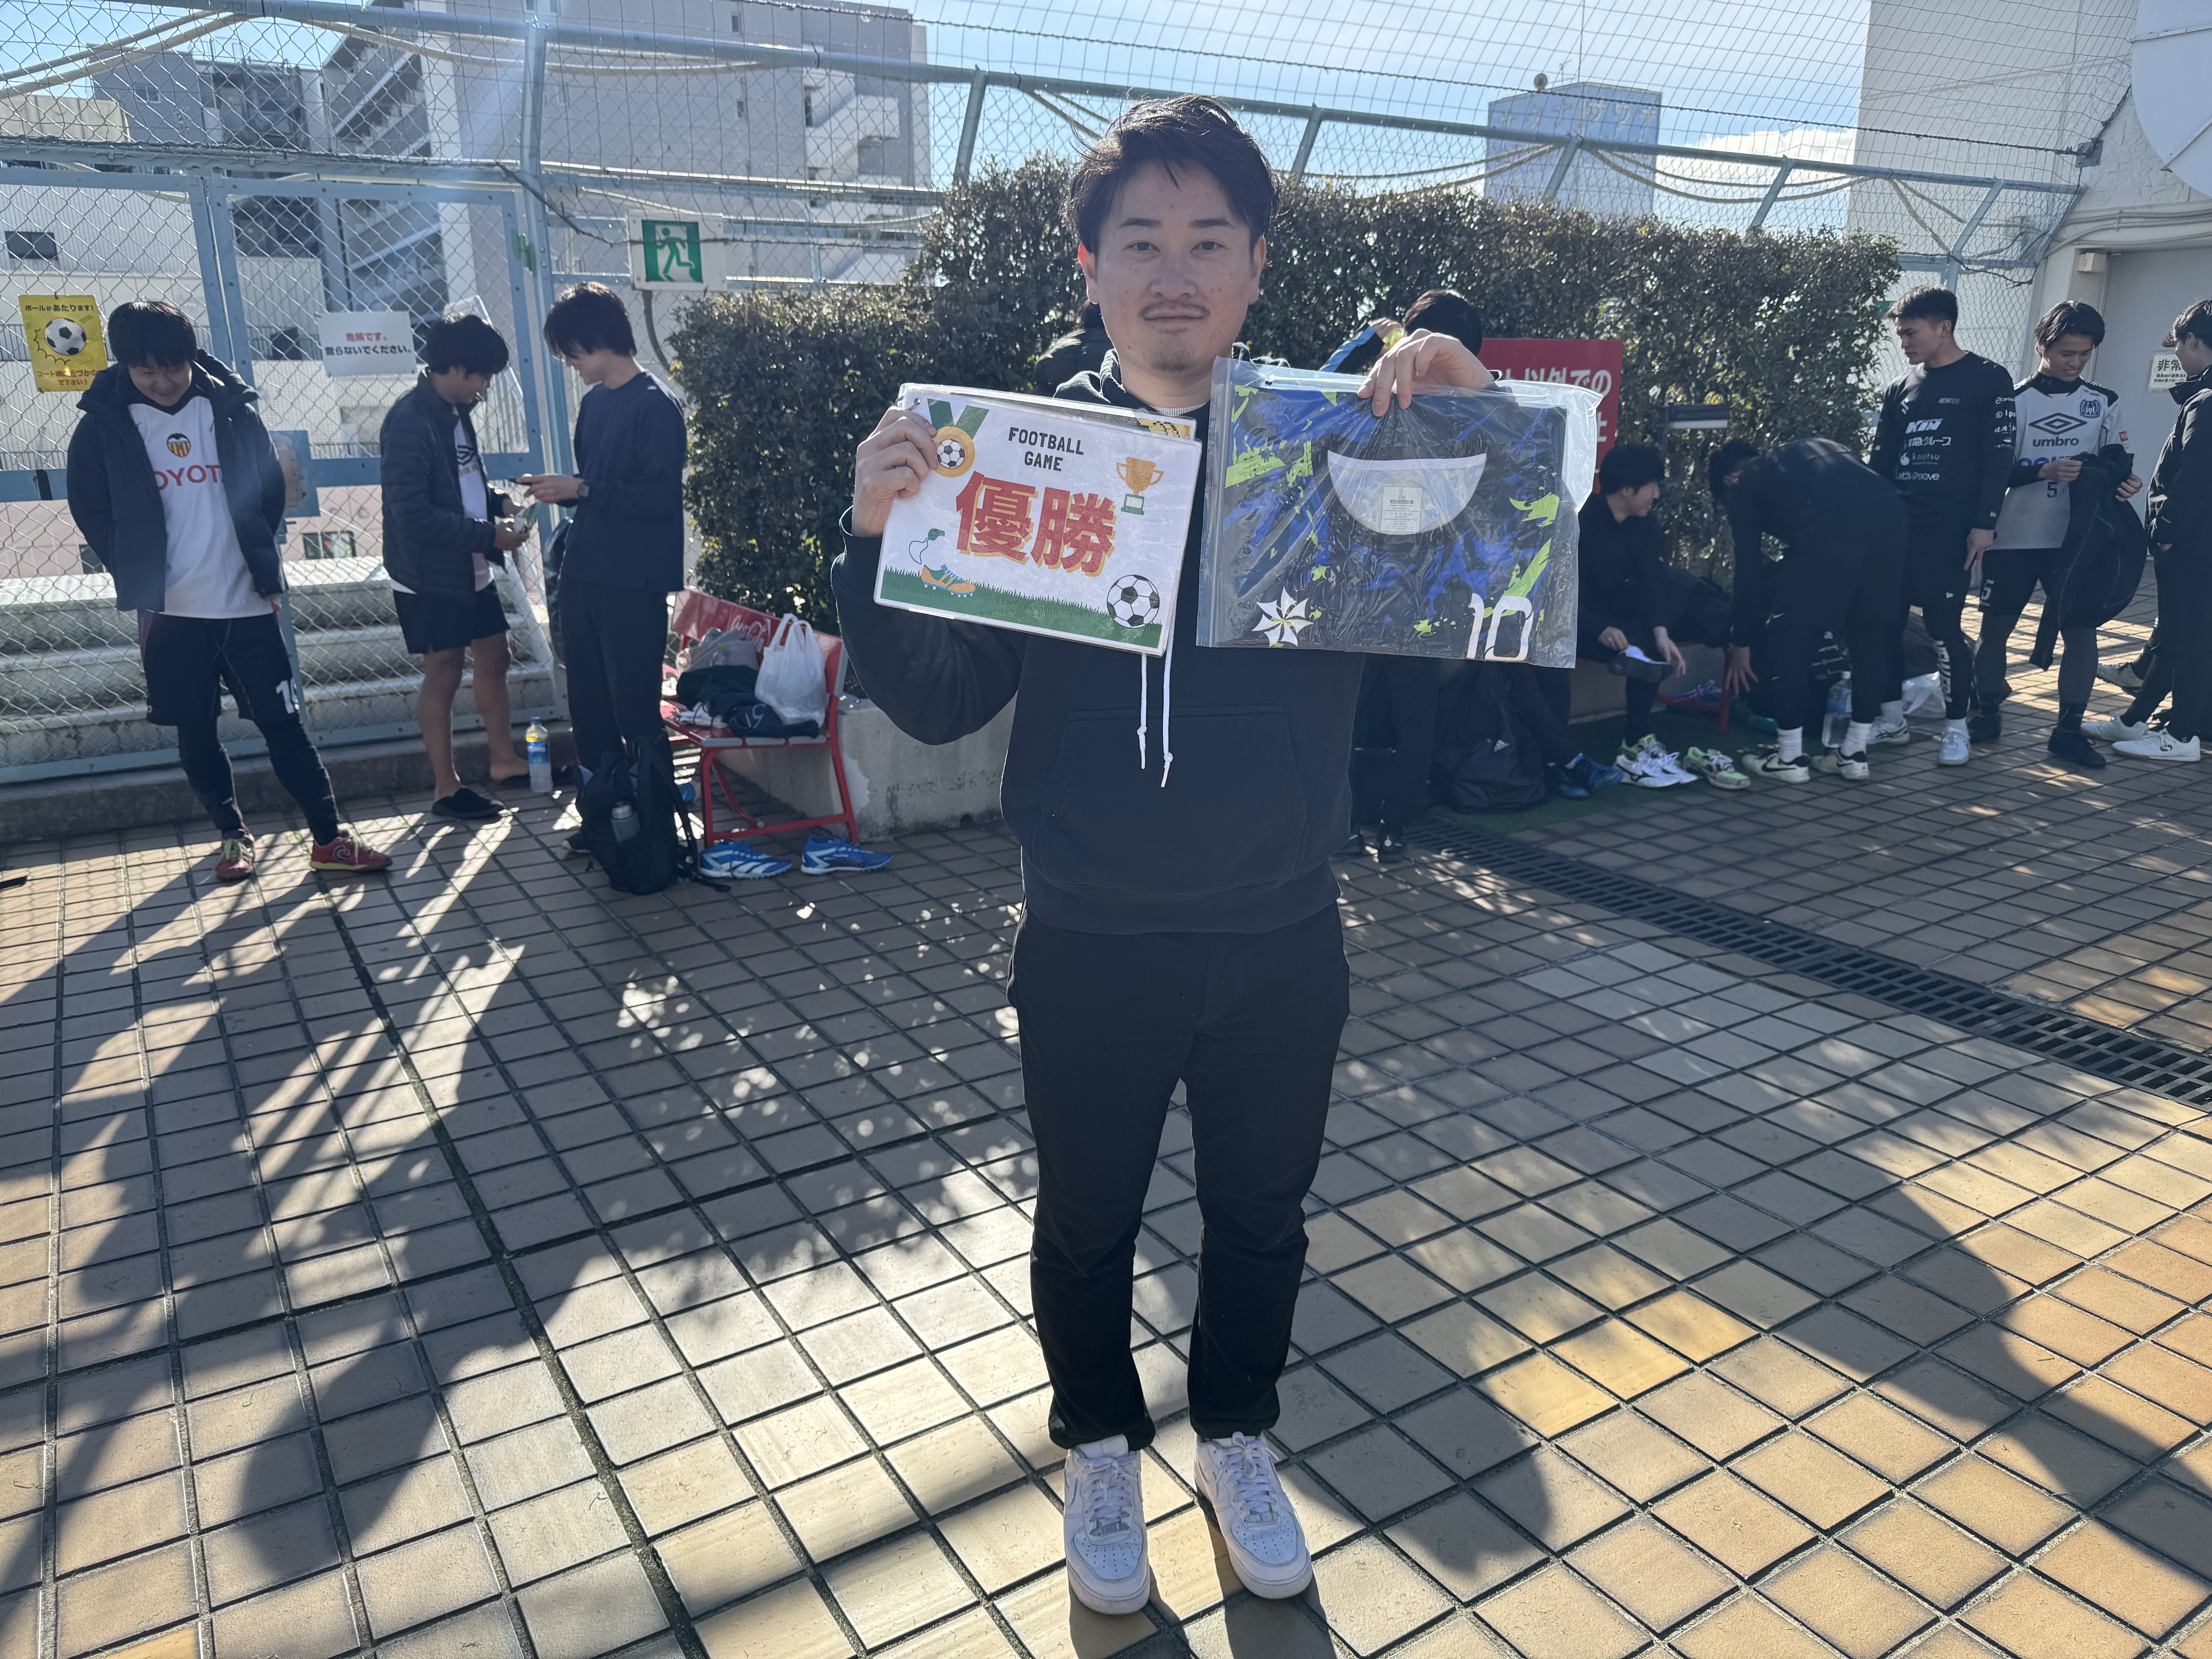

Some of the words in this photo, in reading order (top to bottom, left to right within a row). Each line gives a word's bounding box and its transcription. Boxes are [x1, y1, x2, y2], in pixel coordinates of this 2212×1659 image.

[1589, 101, 1657, 129] サウナ
[1008, 427, 1085, 455] FOOTBALL
[2033, 436, 2079, 447] umbro
[1024, 451, 1064, 472] GAME
[1399, 489, 1405, 500] L
[2047, 481, 2058, 498] 5
[955, 471, 1120, 577] 優勝
[1981, 579, 1995, 600] 5
[1466, 592, 1534, 661] 10
